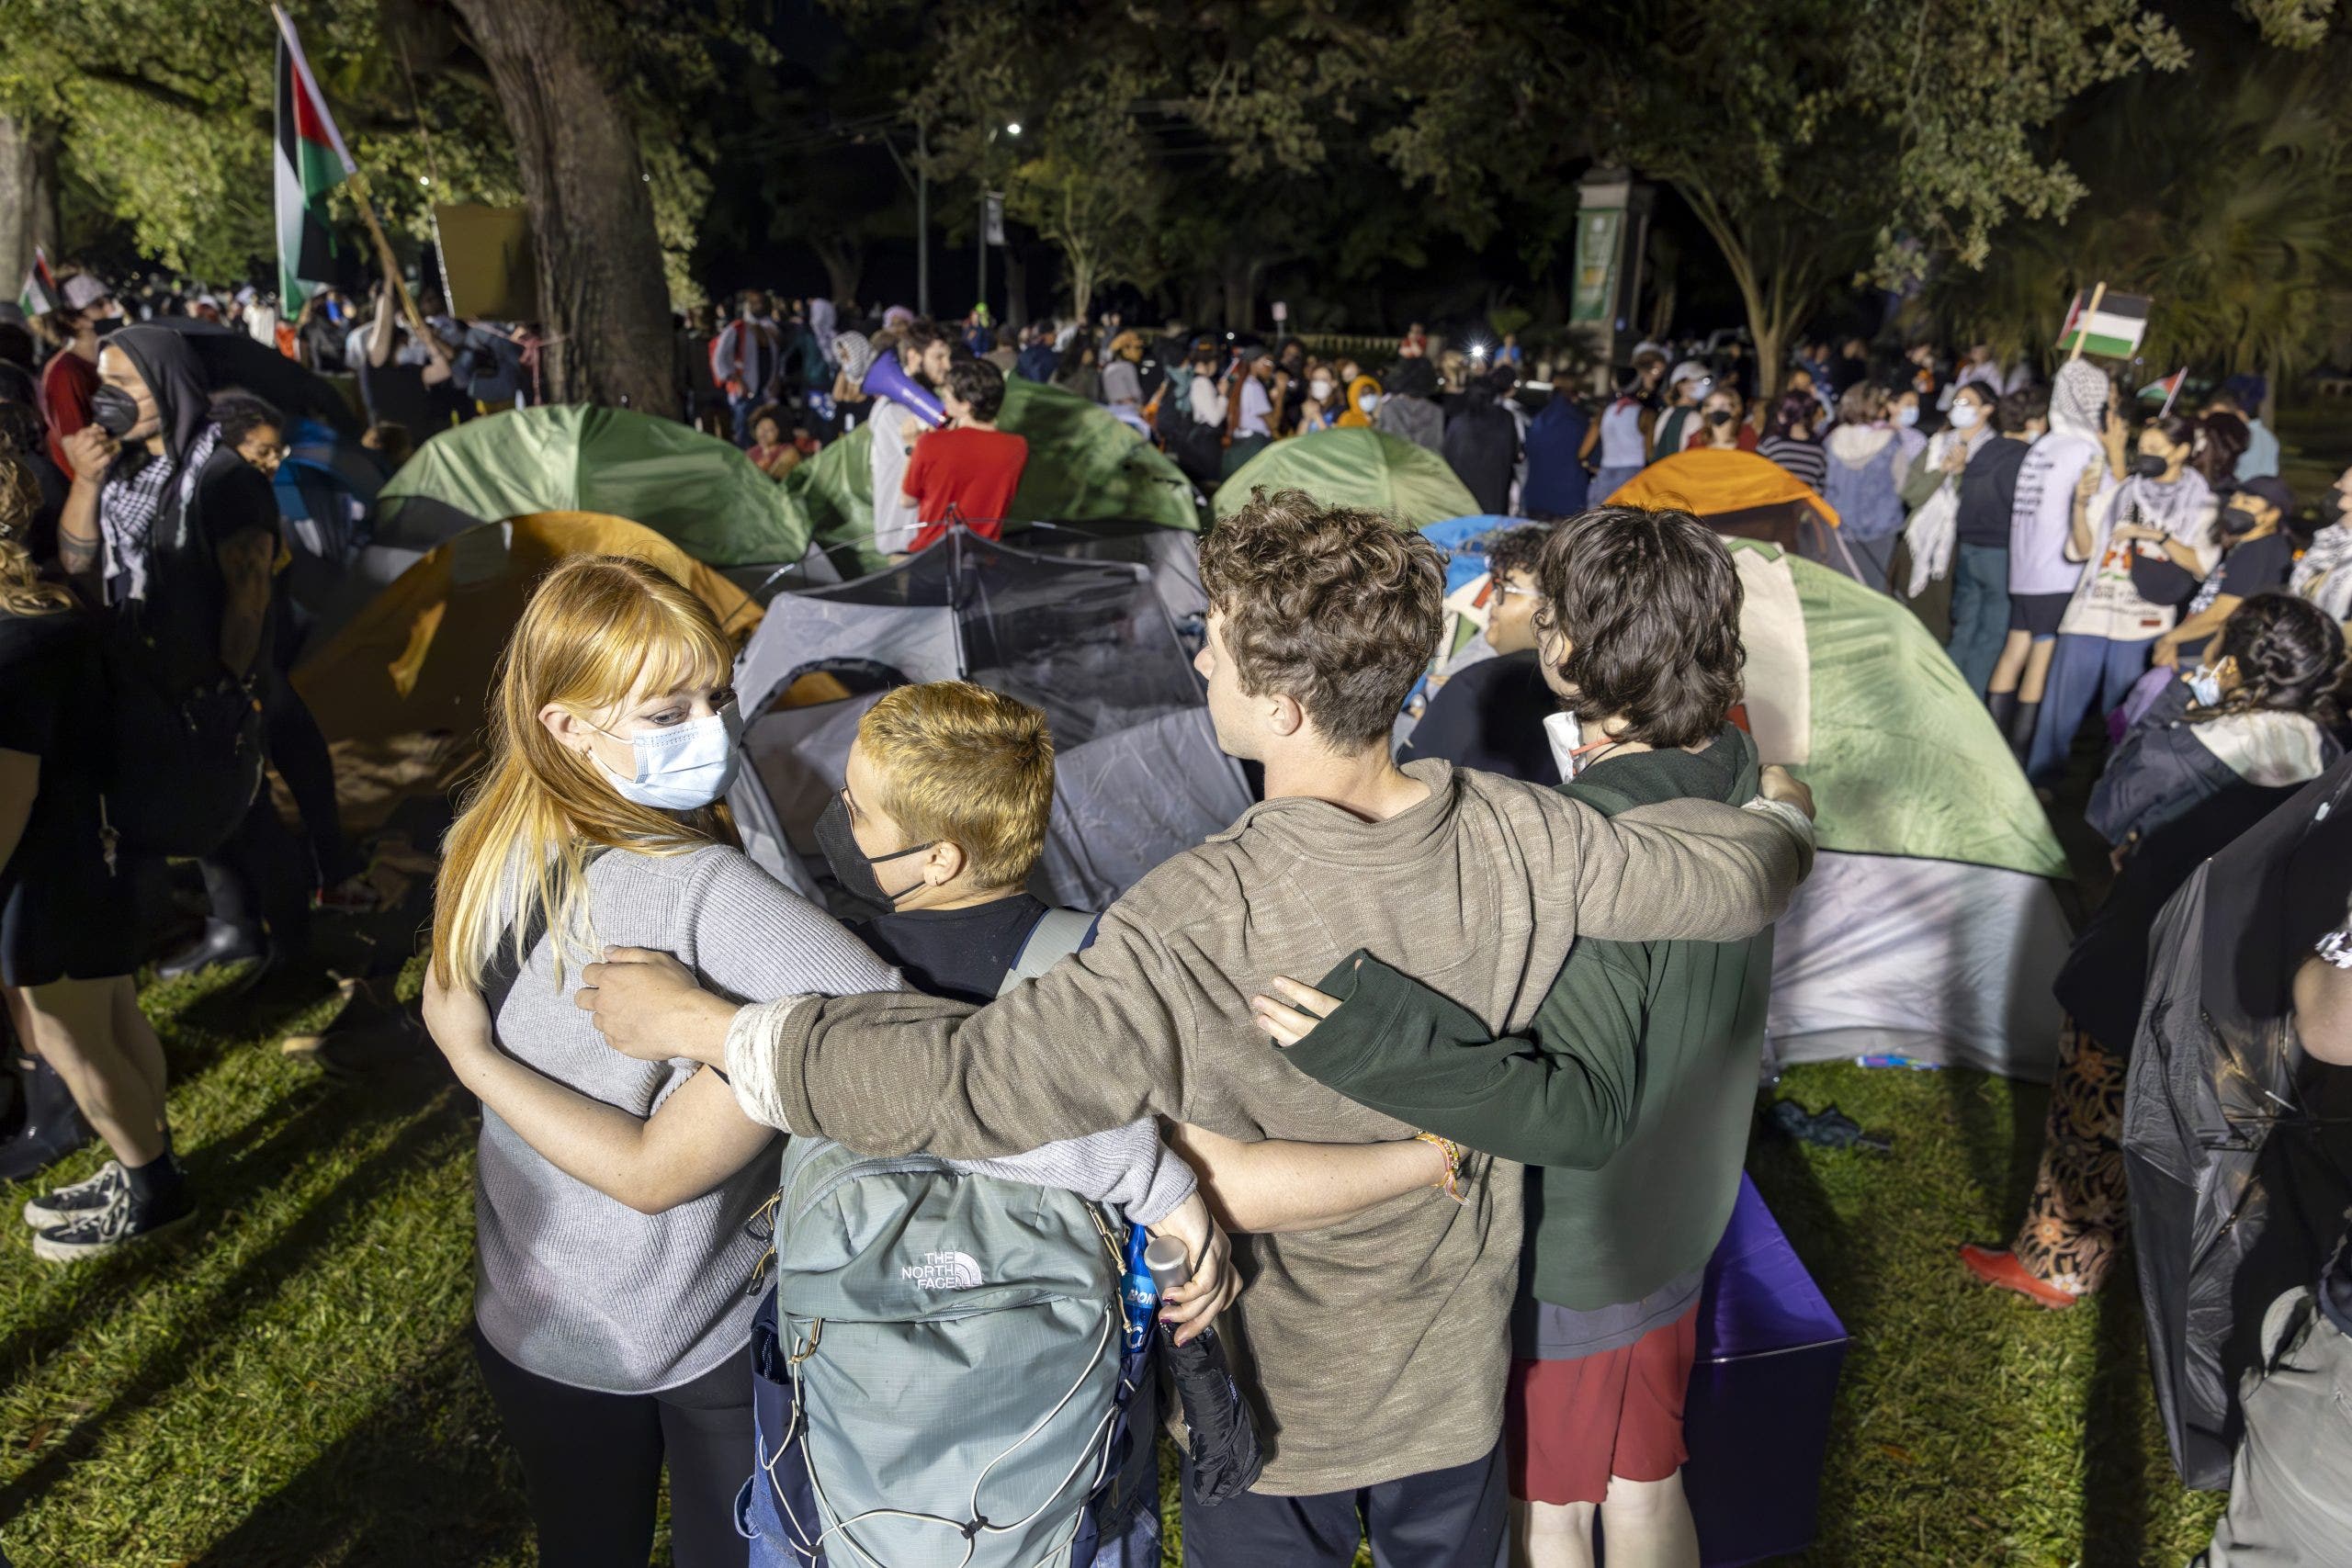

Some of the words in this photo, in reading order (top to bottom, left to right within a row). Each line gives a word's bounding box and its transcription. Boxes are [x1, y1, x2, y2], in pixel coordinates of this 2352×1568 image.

[924, 1251, 955, 1265] THE
[901, 1263, 955, 1280] NORTH
[917, 1277, 956, 1290] FACE
